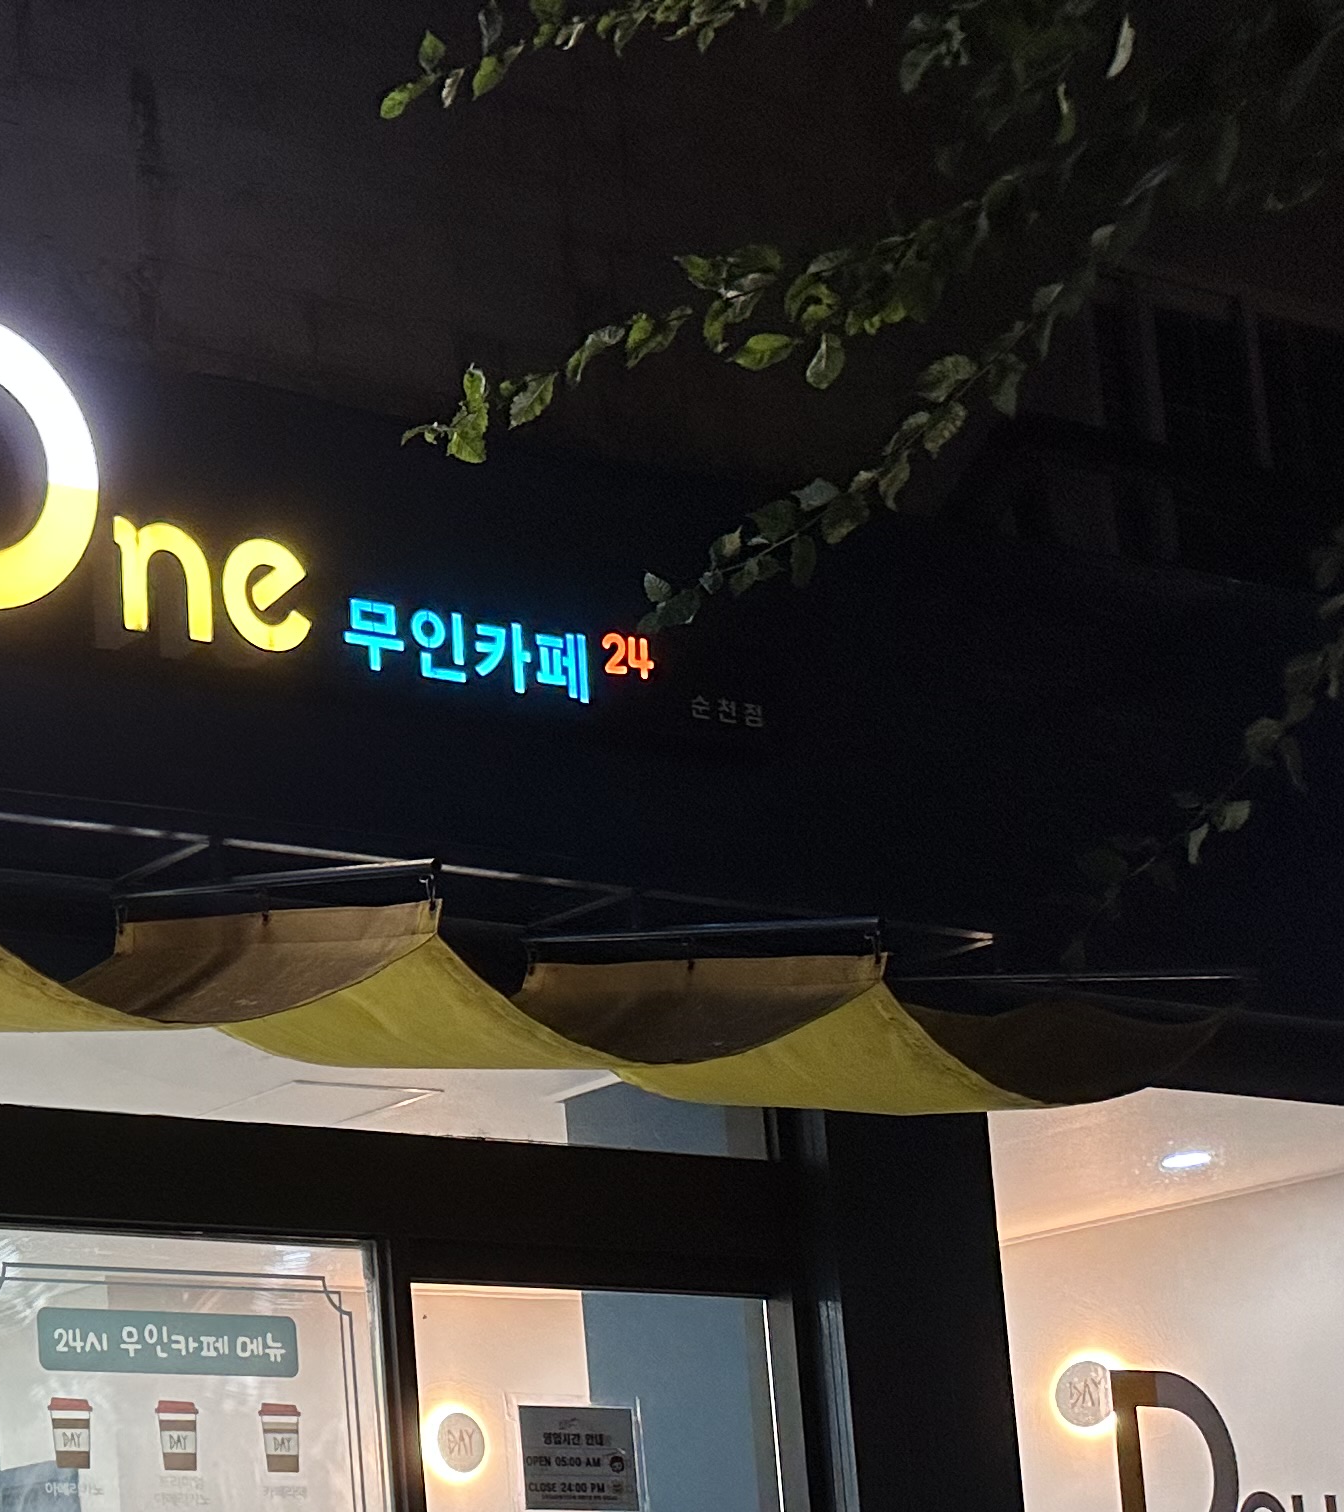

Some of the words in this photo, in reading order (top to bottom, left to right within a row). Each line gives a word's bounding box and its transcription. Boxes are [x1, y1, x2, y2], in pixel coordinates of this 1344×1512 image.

[344, 597, 590, 703] 무인카페
[601, 632, 654, 680] 24
[53, 1325, 109, 1355] 24시
[120, 1322, 230, 1360] 무인카페
[236, 1333, 288, 1364] 메뉴
[62, 1431, 83, 1449] DAY
[169, 1434, 189, 1450] DAY
[273, 1436, 293, 1452] DAY
